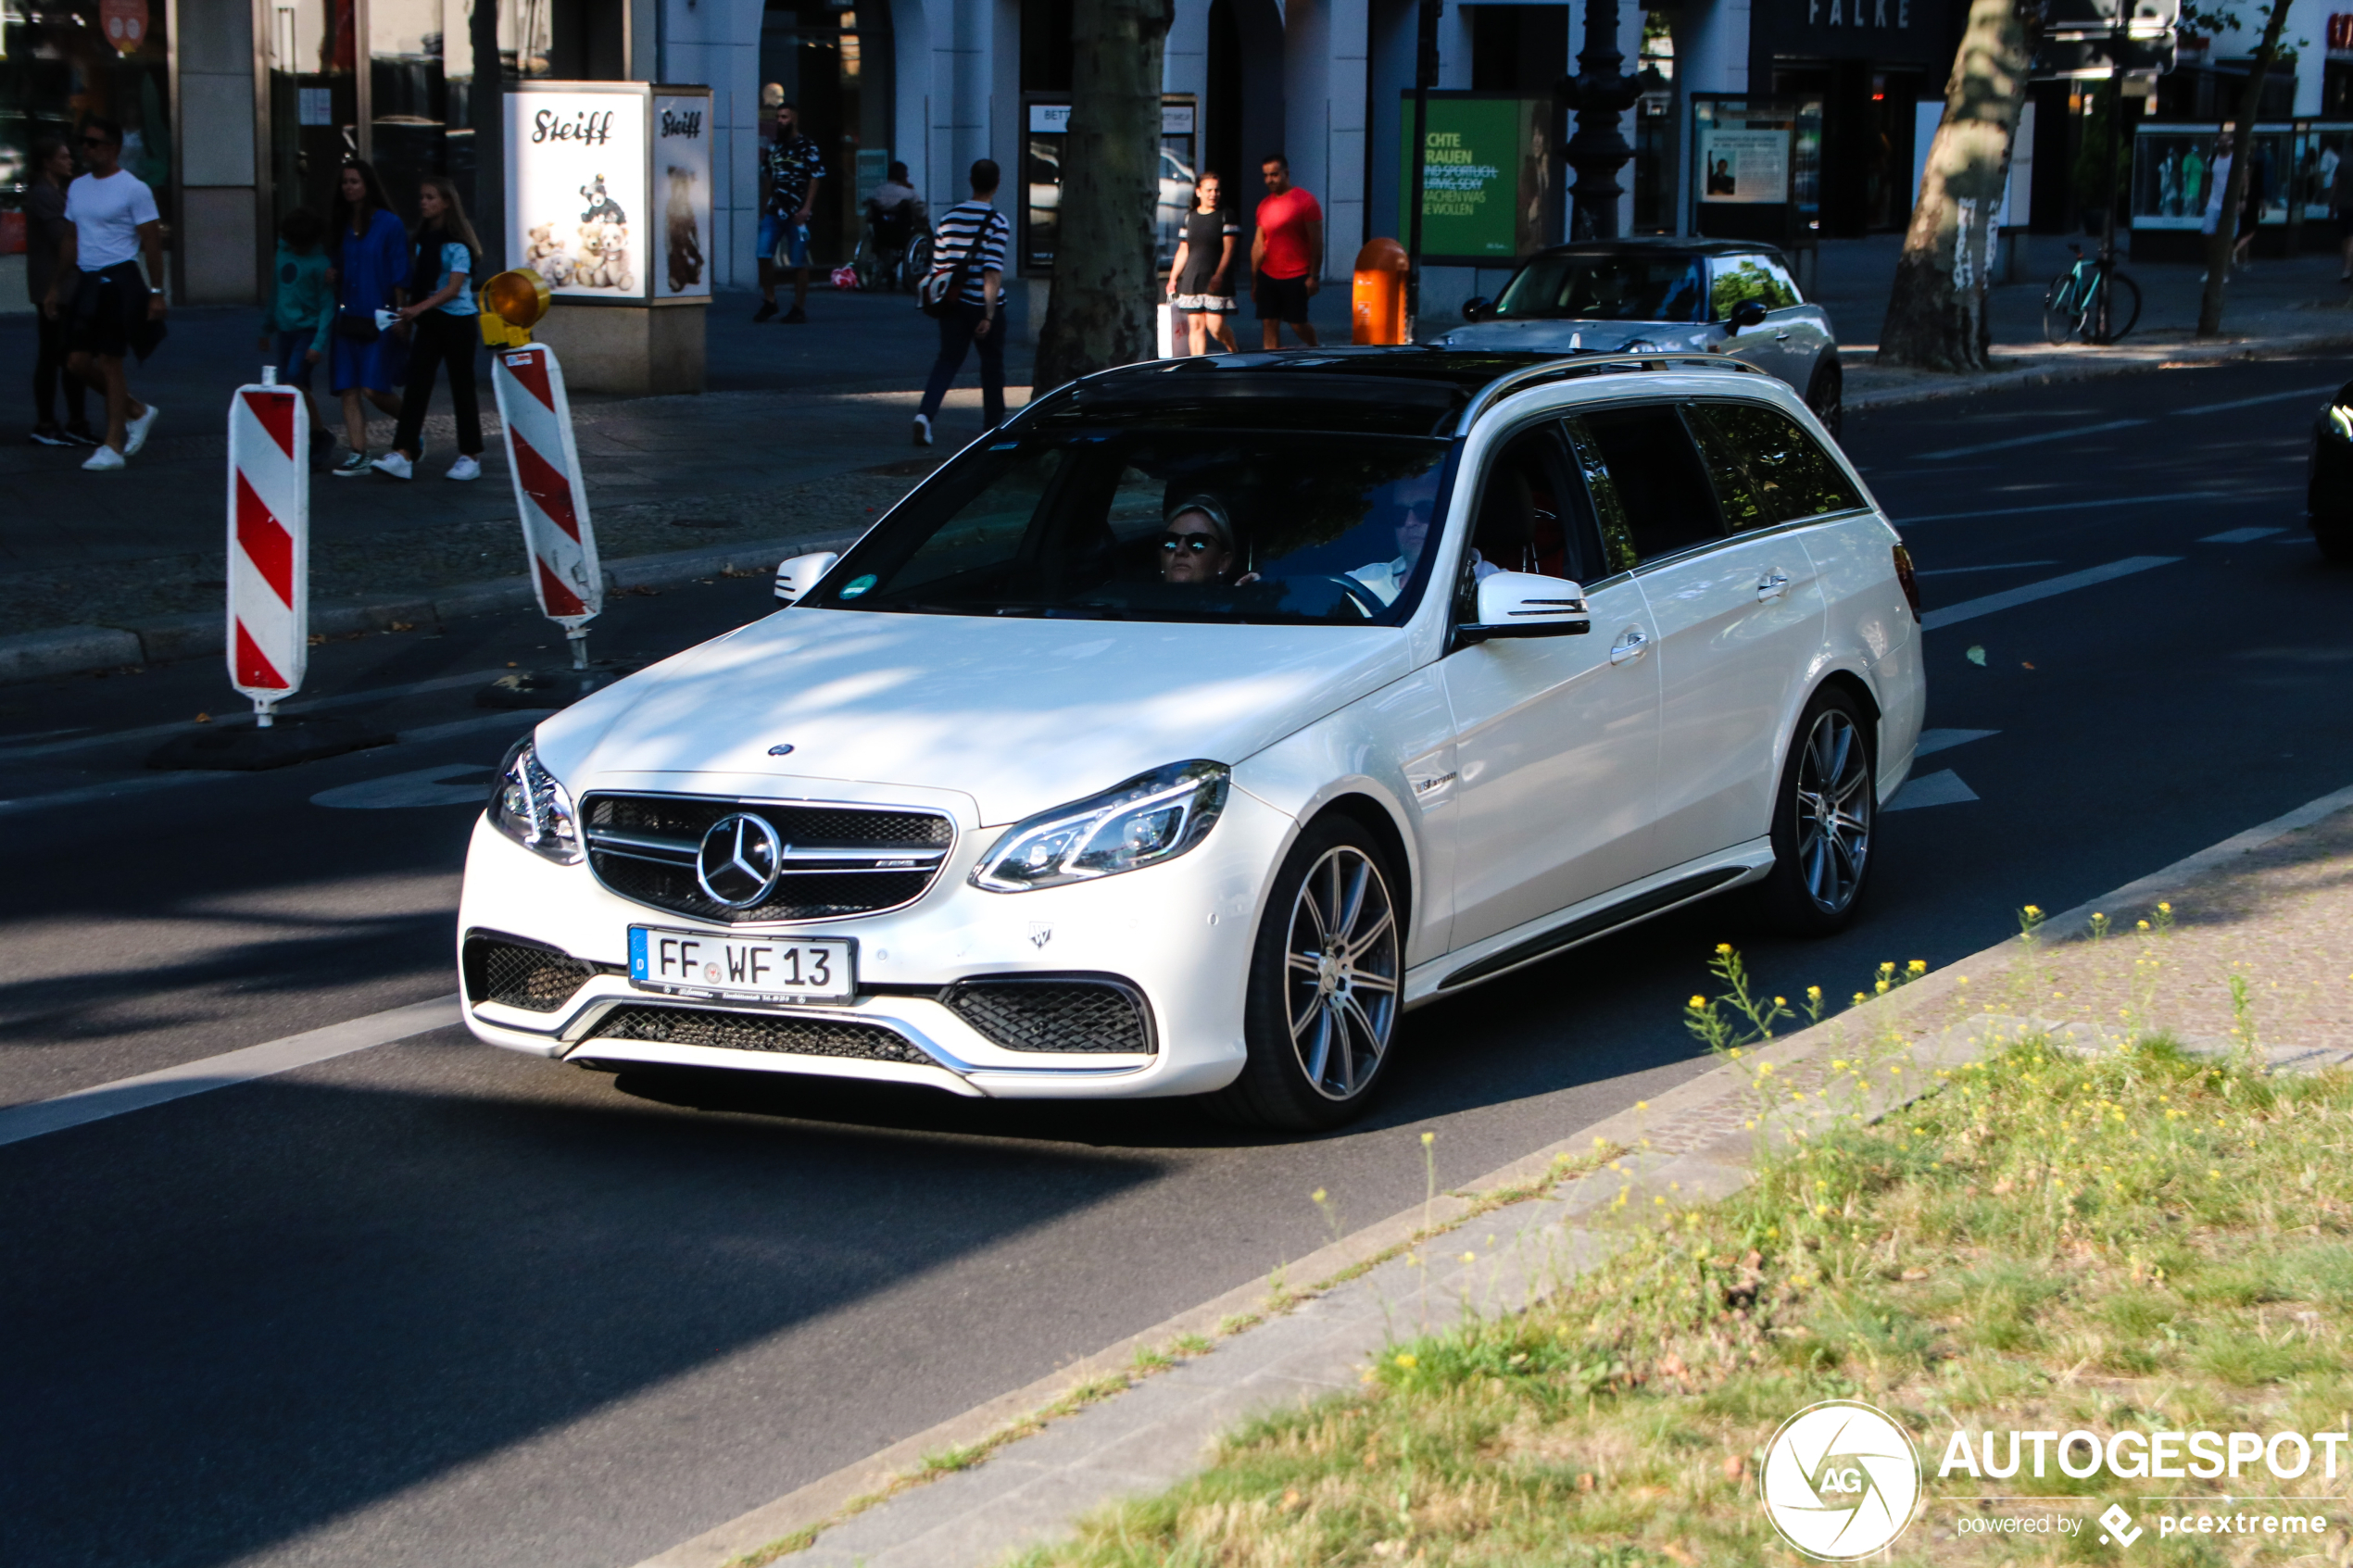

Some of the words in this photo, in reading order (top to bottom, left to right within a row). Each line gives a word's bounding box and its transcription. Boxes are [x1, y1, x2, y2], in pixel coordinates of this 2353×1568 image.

[1809, 0, 1908, 28] FALKE
[1044, 109, 1071, 120] BETT
[532, 109, 614, 146] Steiff
[661, 110, 702, 139] Steiff
[1425, 133, 1461, 147] CHTE
[1424, 150, 1472, 164] RAUEN
[1423, 165, 1441, 177] IND
[1423, 177, 1456, 191] URVIG,
[1458, 178, 1482, 191] SEXY
[1463, 191, 1486, 204] WAS
[1432, 204, 1474, 216] WOLLEN
[635, 958, 645, 971] D
[661, 938, 700, 978] FF
[726, 945, 773, 984] WF
[784, 948, 831, 986] 13
